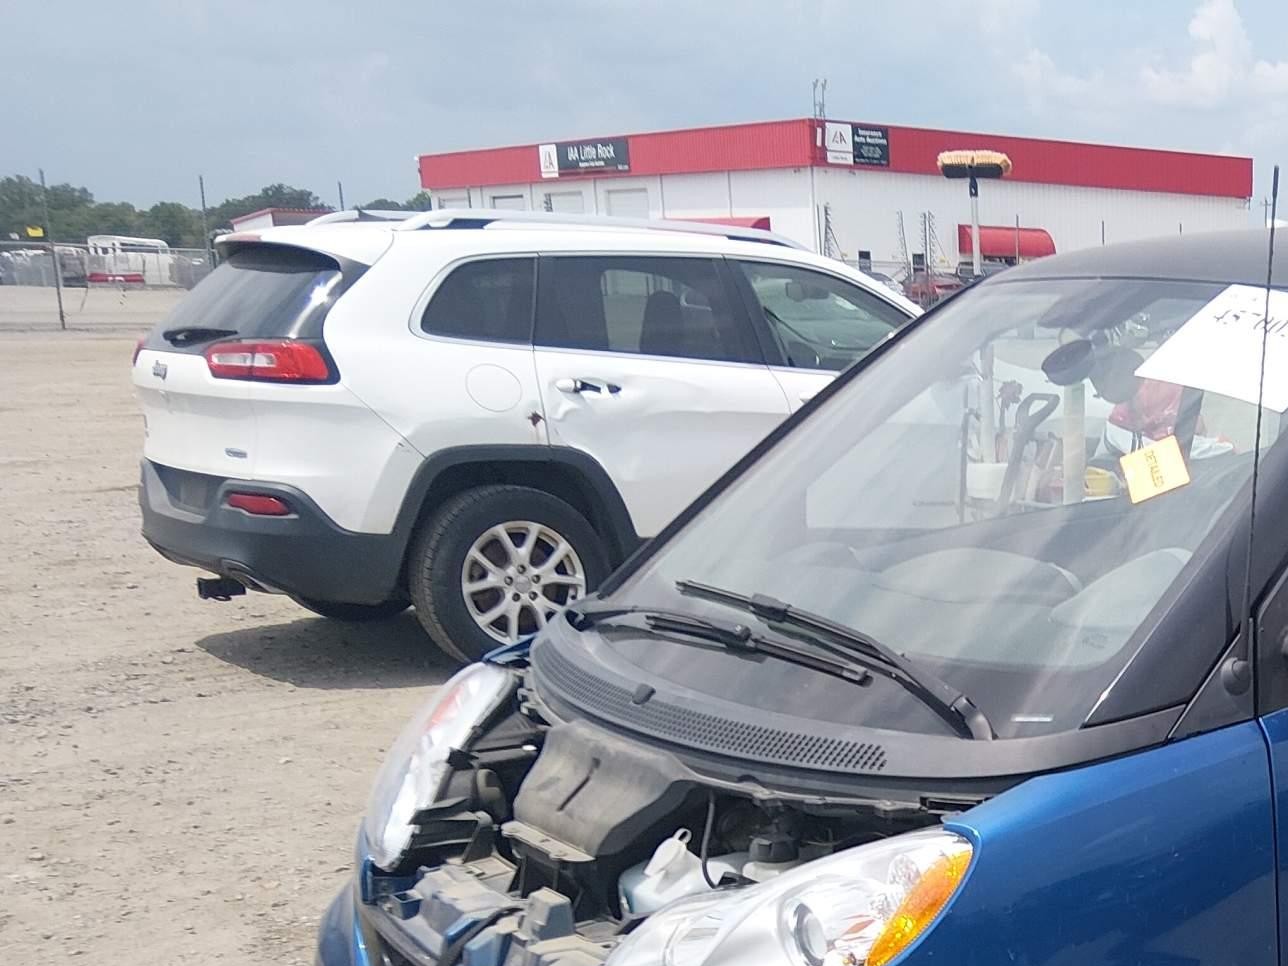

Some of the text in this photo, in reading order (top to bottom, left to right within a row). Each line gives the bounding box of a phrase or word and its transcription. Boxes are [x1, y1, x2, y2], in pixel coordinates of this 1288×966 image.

[567, 143, 615, 161] IAA Little Rock
